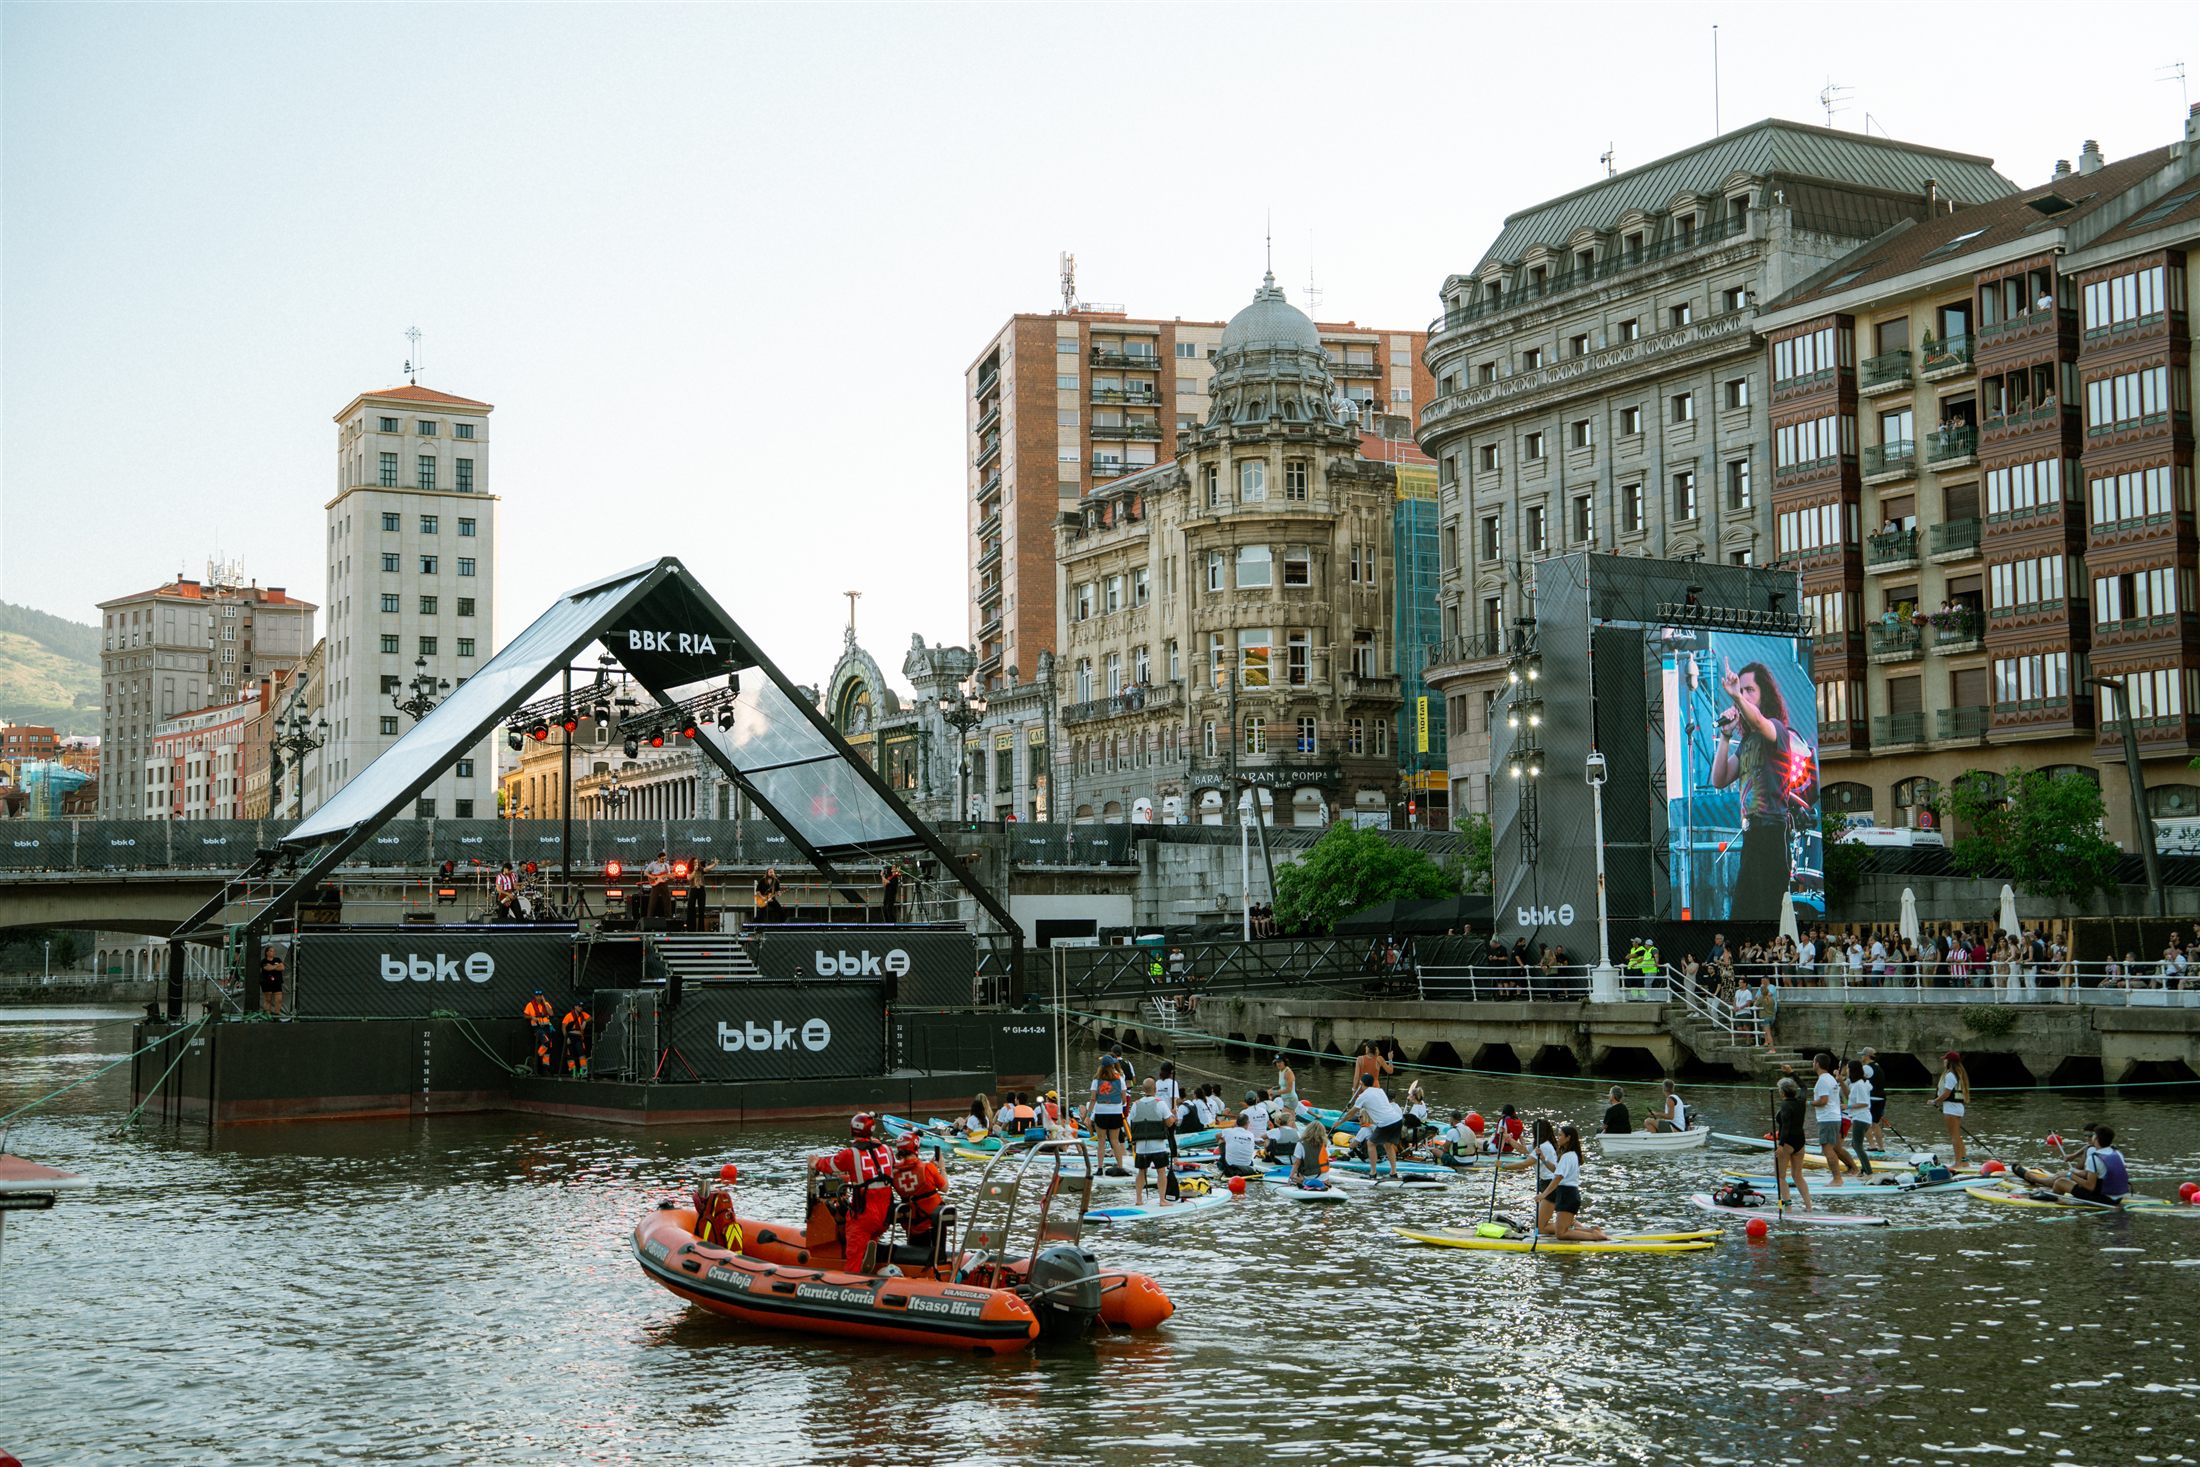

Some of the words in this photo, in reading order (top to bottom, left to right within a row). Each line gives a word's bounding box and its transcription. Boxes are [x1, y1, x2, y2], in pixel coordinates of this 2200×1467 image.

[629, 629, 672, 652] BBK
[679, 633, 717, 655] RIA
[1517, 905, 1557, 926] bbk
[381, 953, 461, 982] bbk
[816, 950, 881, 976] bbk
[717, 1020, 798, 1052] bbk
[1012, 1026, 1046, 1034] GI-4-1-24
[707, 1265, 729, 1281] Cruz
[729, 1272, 752, 1289] Roja
[796, 1283, 839, 1300] Gurutze
[840, 1289, 875, 1305] Gorria
[944, 1288, 990, 1300] VANGUARD
[908, 1297, 949, 1314] Itsaso
[950, 1301, 982, 1317] Hiru
